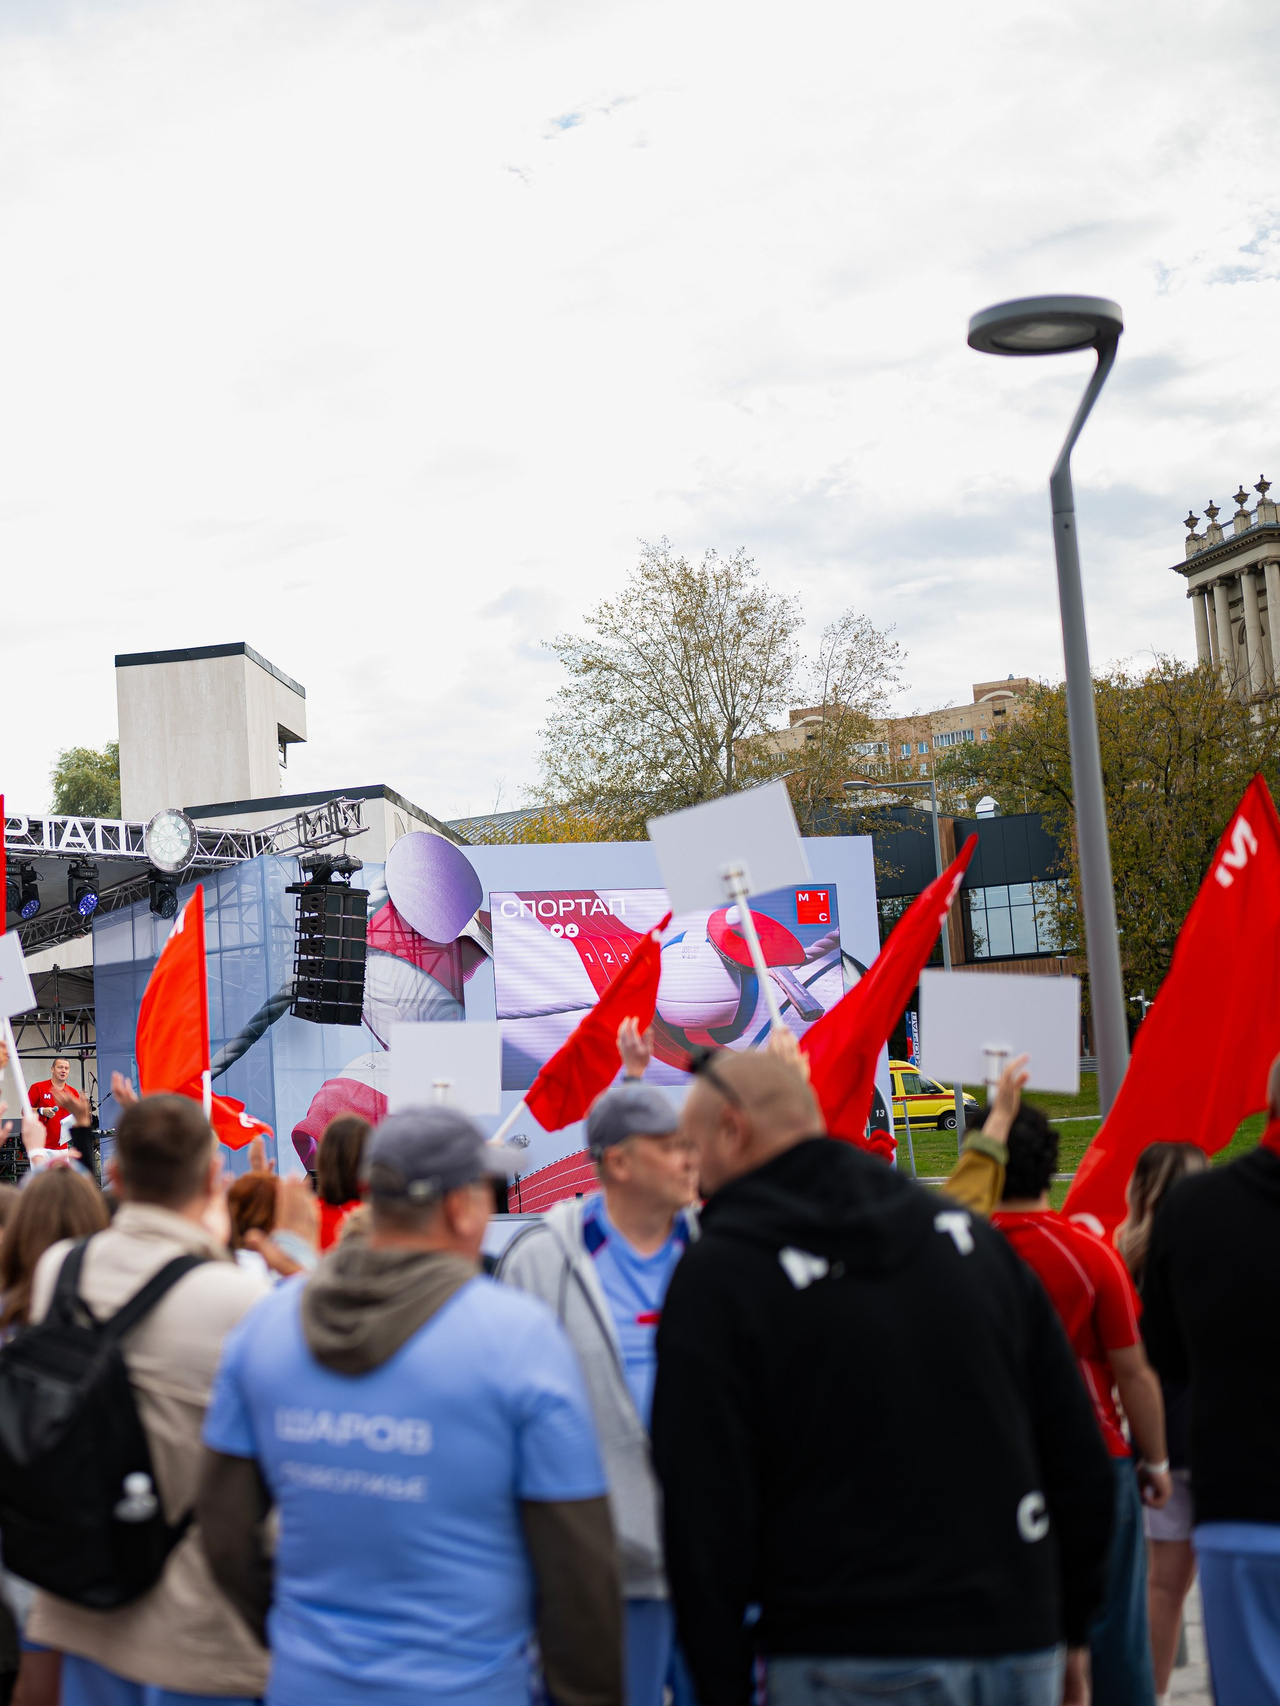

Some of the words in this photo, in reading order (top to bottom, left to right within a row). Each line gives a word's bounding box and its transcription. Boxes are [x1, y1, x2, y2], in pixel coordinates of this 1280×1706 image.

[798, 893, 809, 902] М
[817, 892, 826, 901] Т
[500, 898, 626, 918] СПОРТАП
[818, 912, 828, 922] С
[585, 953, 594, 963] 1
[603, 953, 615, 963] 2
[621, 953, 629, 963] 3
[875, 1109, 885, 1118] 13
